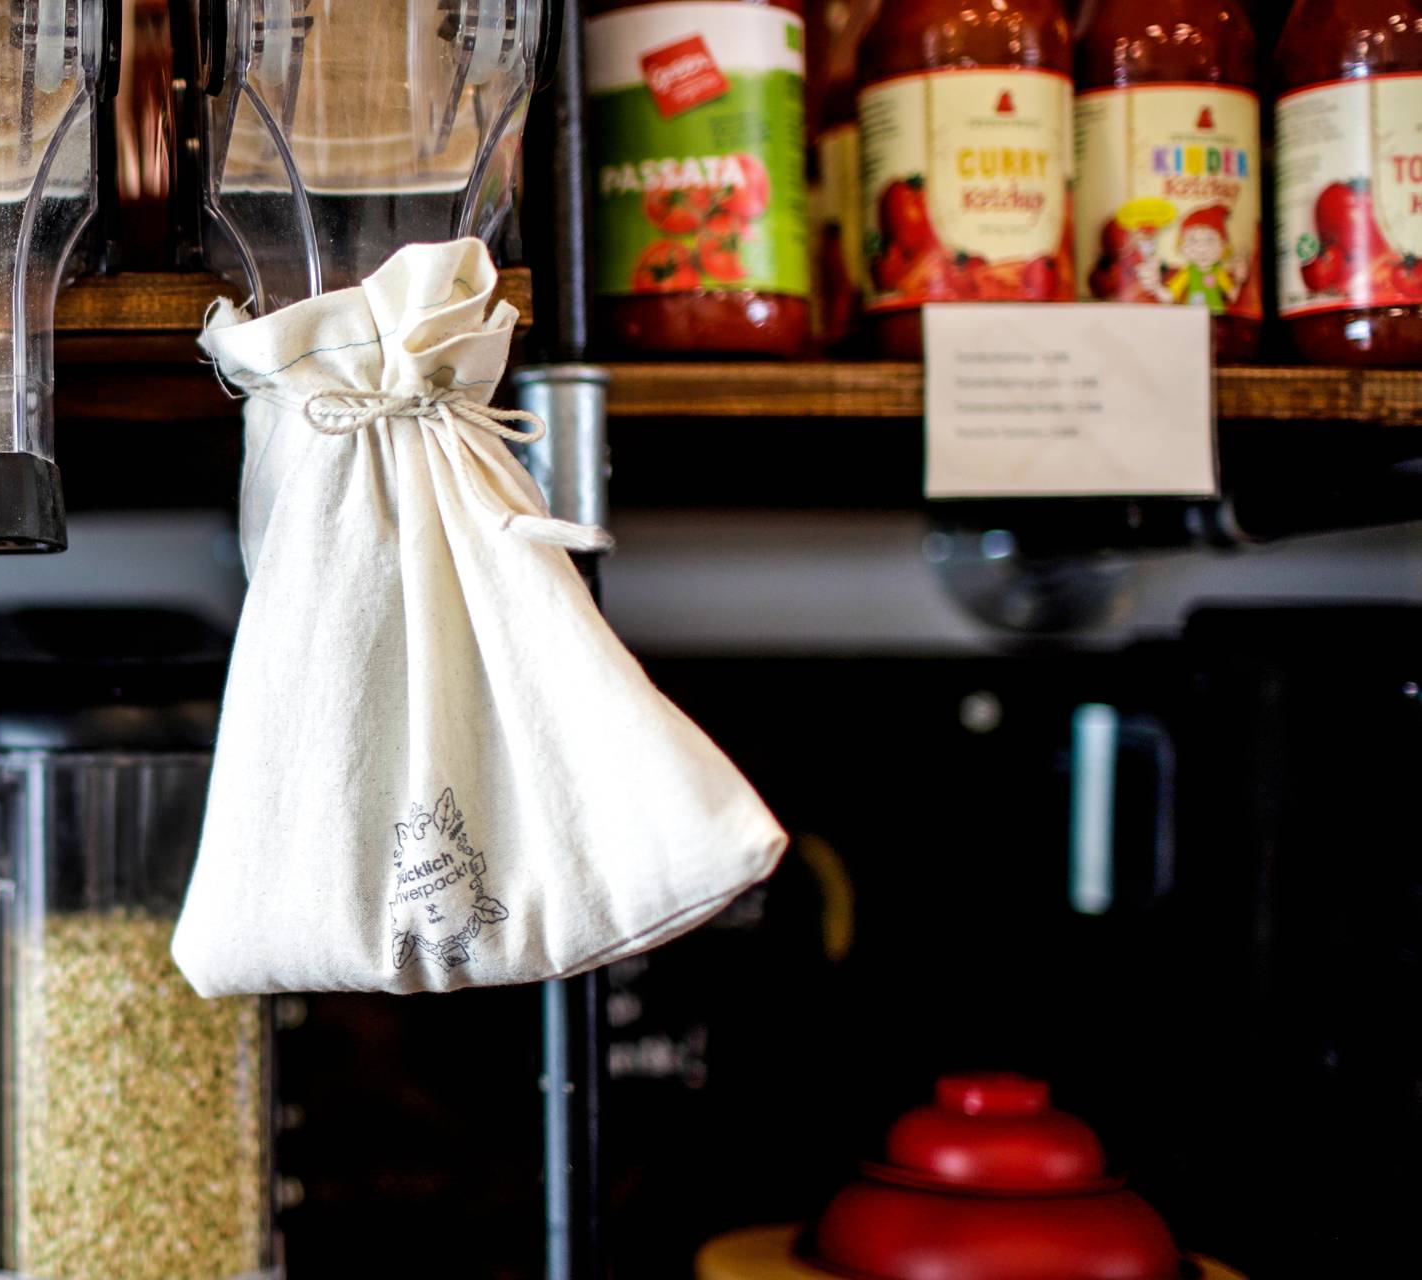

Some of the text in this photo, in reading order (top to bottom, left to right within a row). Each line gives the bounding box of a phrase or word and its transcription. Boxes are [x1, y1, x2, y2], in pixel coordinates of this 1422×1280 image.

[602, 156, 746, 195] PASSATA
[956, 147, 1049, 178] CURRY
[1153, 147, 1248, 178] KINDER
[395, 861, 468, 904] nverpackt
[397, 852, 454, 889] ücklich
